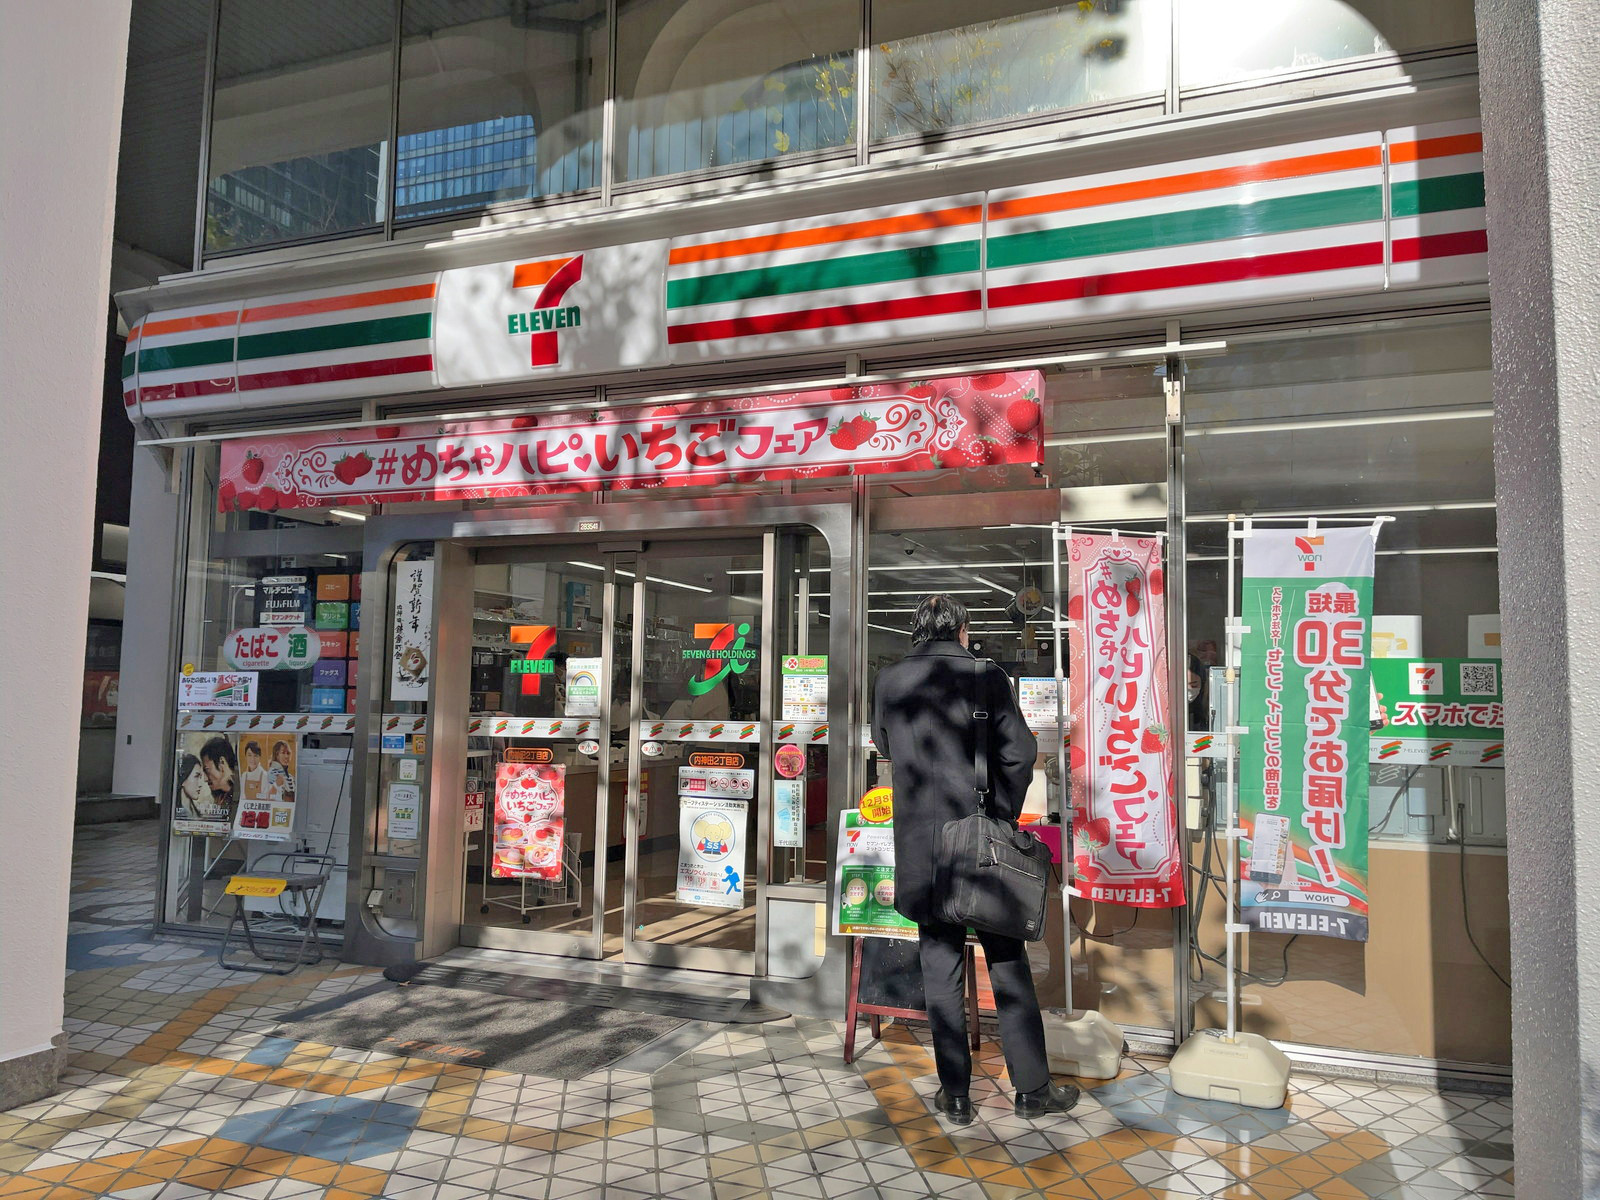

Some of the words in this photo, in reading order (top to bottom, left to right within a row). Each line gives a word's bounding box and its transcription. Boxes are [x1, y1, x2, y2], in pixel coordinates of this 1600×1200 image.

[594, 418, 828, 471] いちごフェア
[235, 633, 279, 658] たばこ
[287, 633, 308, 658] 酒
[716, 649, 756, 659] HOLDINGS
[243, 660, 270, 668] cigarette
[288, 660, 307, 668] liquor
[694, 756, 740, 766] 内神田2丁目店
[872, 805, 891, 818] 開始
[706, 841, 720, 850] SS
